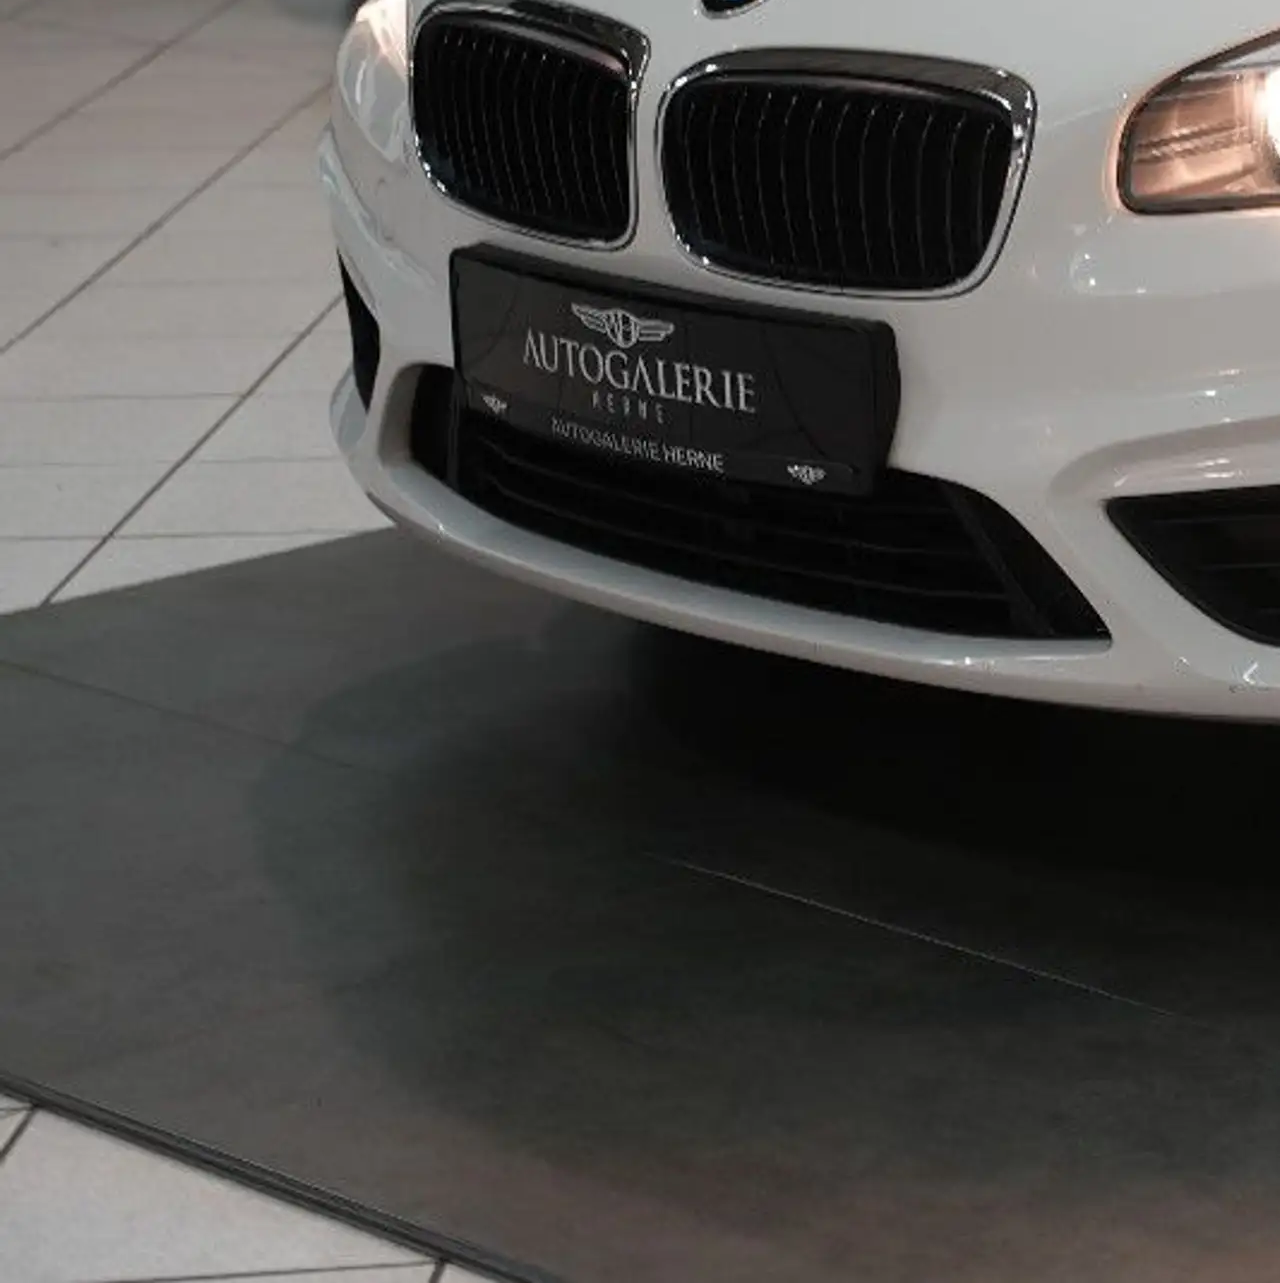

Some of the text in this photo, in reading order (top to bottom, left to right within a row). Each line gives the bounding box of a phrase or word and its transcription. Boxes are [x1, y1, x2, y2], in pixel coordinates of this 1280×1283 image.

[522, 327, 757, 414] AUTOGALERIE
[551, 416, 725, 473] AUTOGALERIE HERNE
